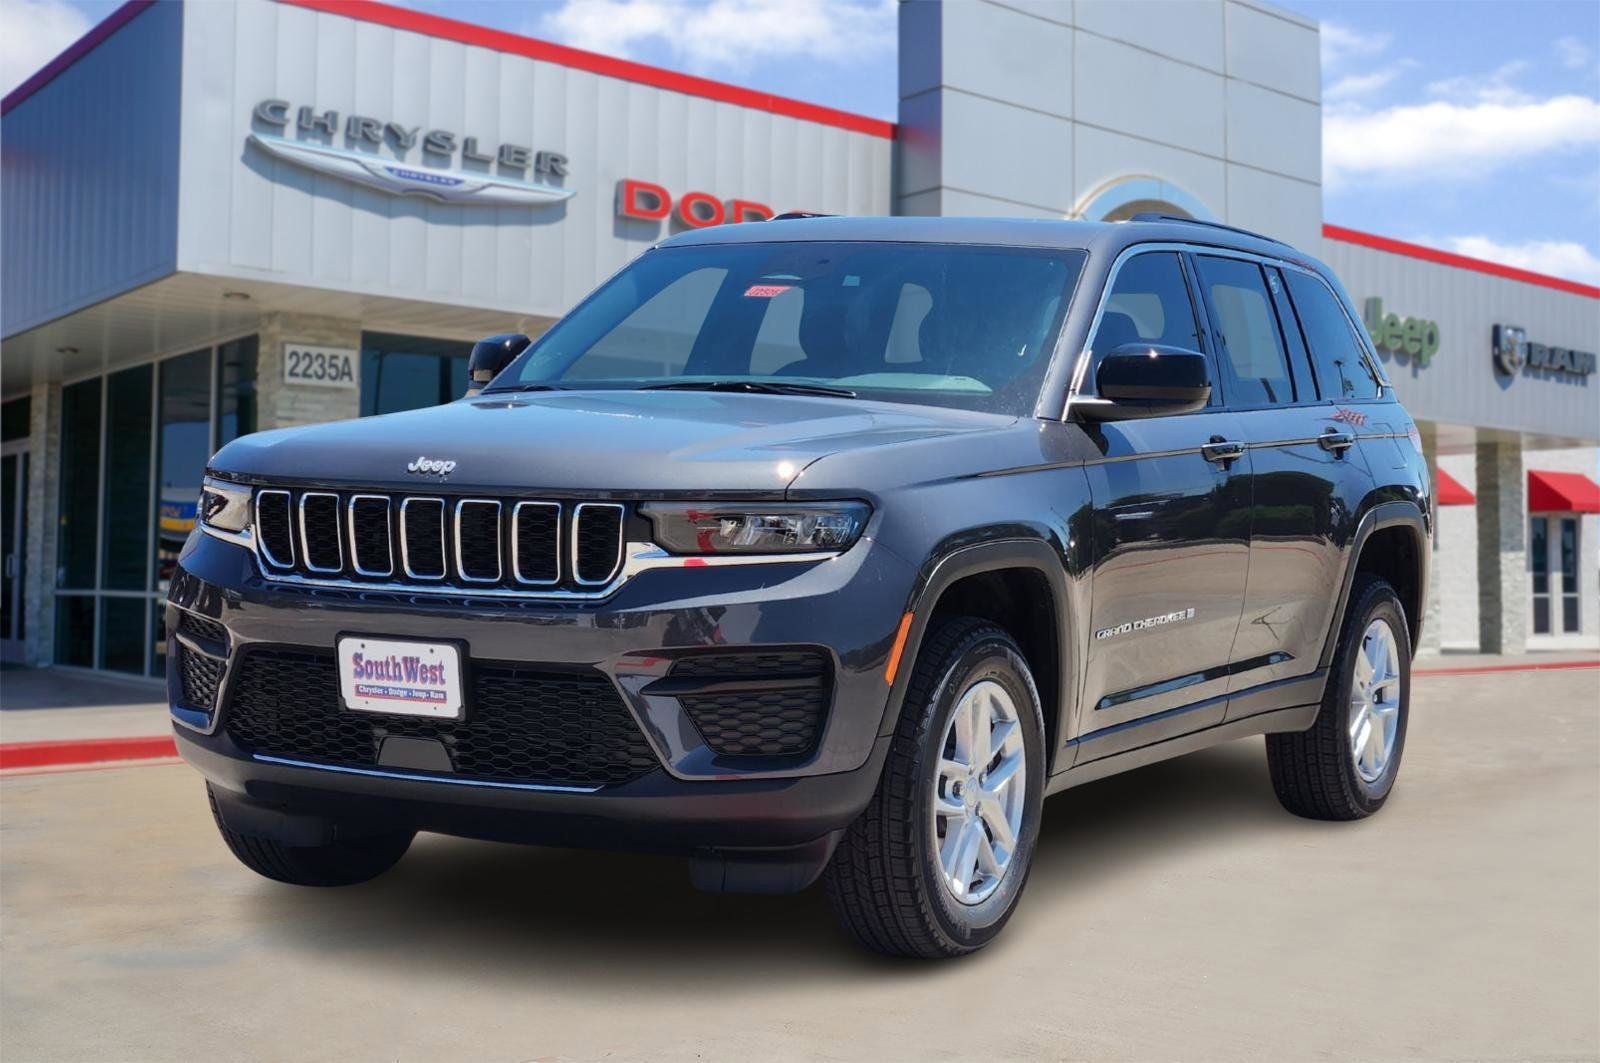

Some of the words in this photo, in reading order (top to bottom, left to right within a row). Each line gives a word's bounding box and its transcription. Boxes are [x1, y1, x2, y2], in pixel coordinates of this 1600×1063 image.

[251, 99, 570, 176] CHRYSLER
[617, 178, 812, 228] DOD
[1364, 296, 1440, 366] Jeep
[288, 350, 353, 382] 2235A
[1526, 341, 1596, 375] RAM
[407, 456, 457, 475] Jeep
[1096, 623, 1132, 639] GRAND
[1133, 610, 1186, 630] CHEROKEE
[353, 652, 445, 685] SouthWest
